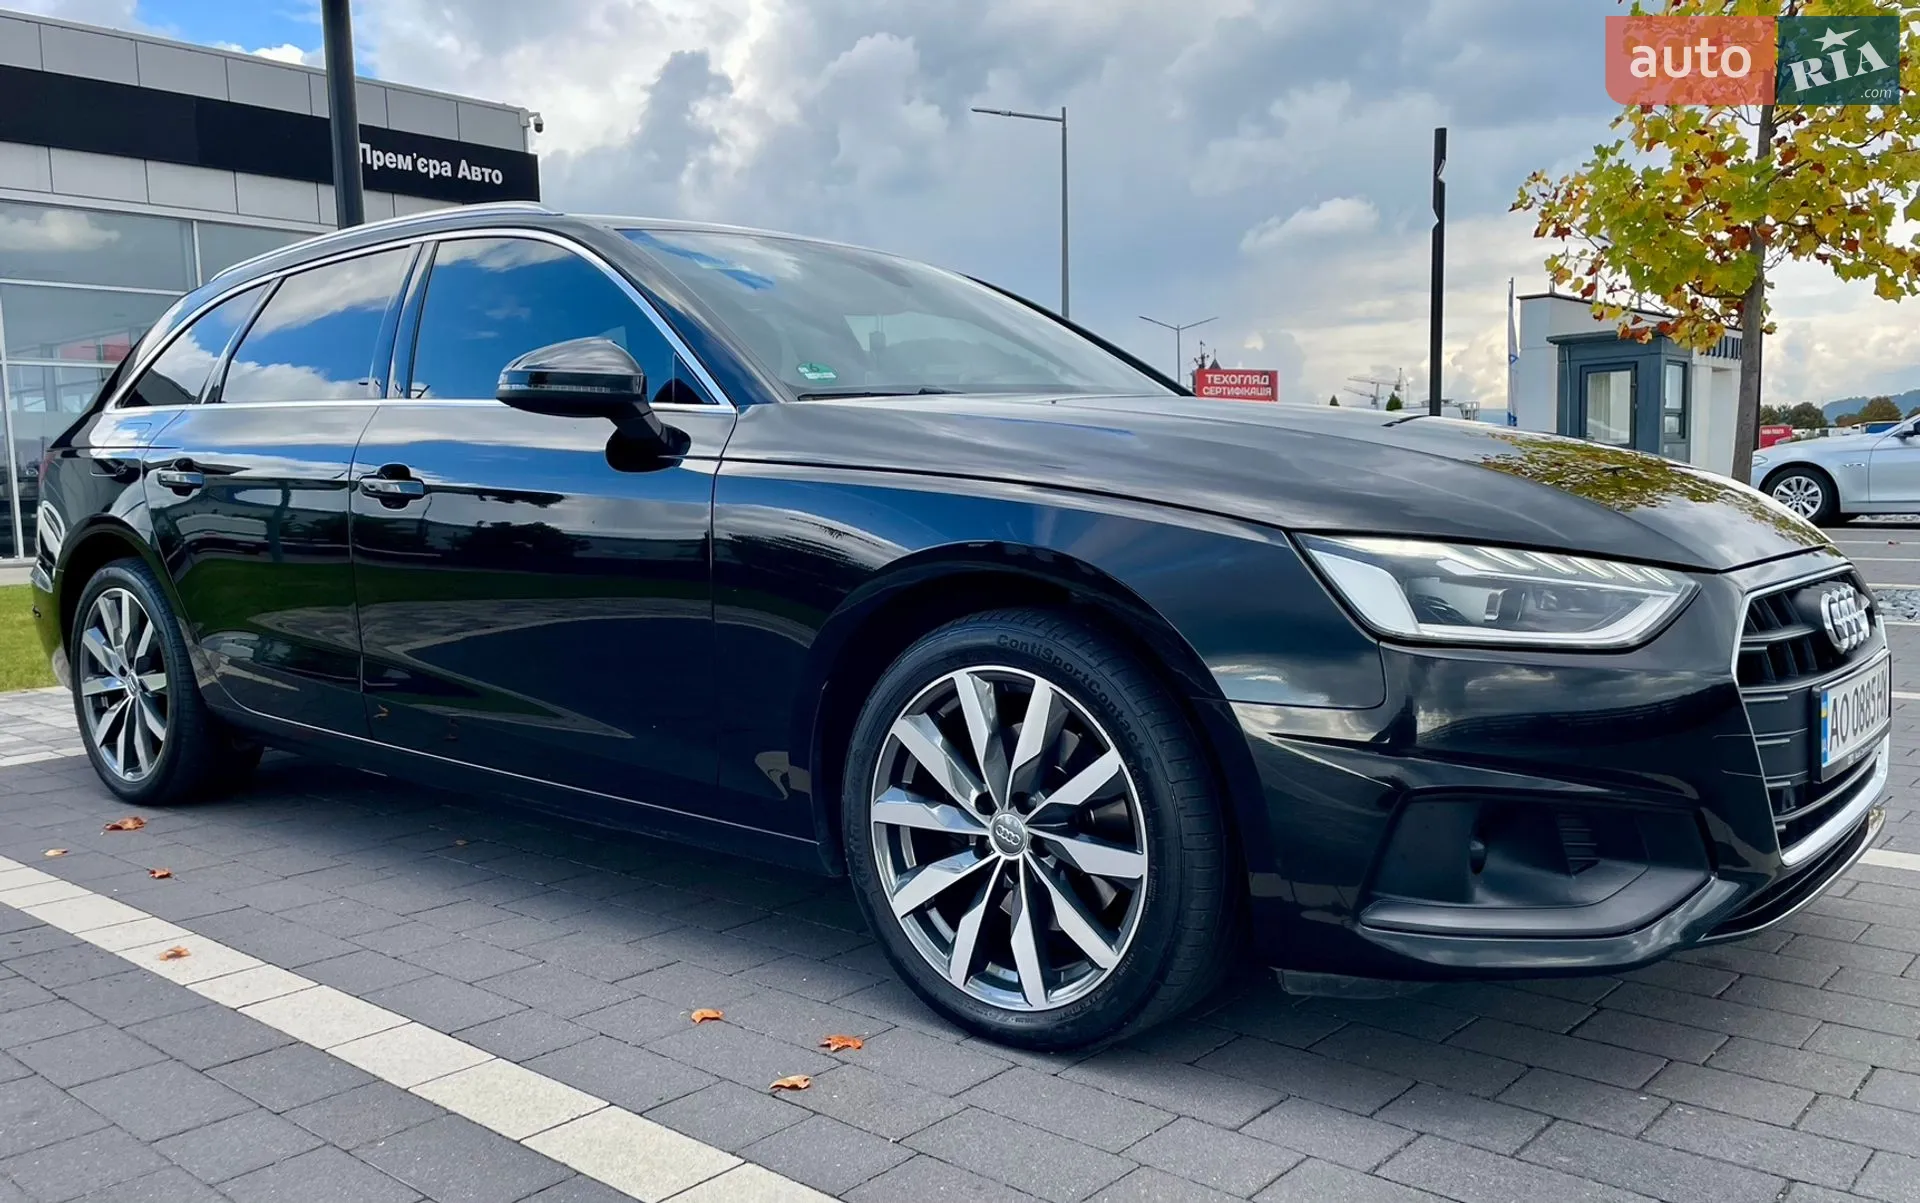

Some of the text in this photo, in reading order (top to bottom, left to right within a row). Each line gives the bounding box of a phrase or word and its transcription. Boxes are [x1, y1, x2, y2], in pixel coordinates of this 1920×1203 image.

[359, 142, 504, 185] Прем'єра Авто
[1205, 374, 1270, 385] ТЕХОГЛЯД
[1202, 386, 1272, 396] СЕРТИФІКАЦІЯ
